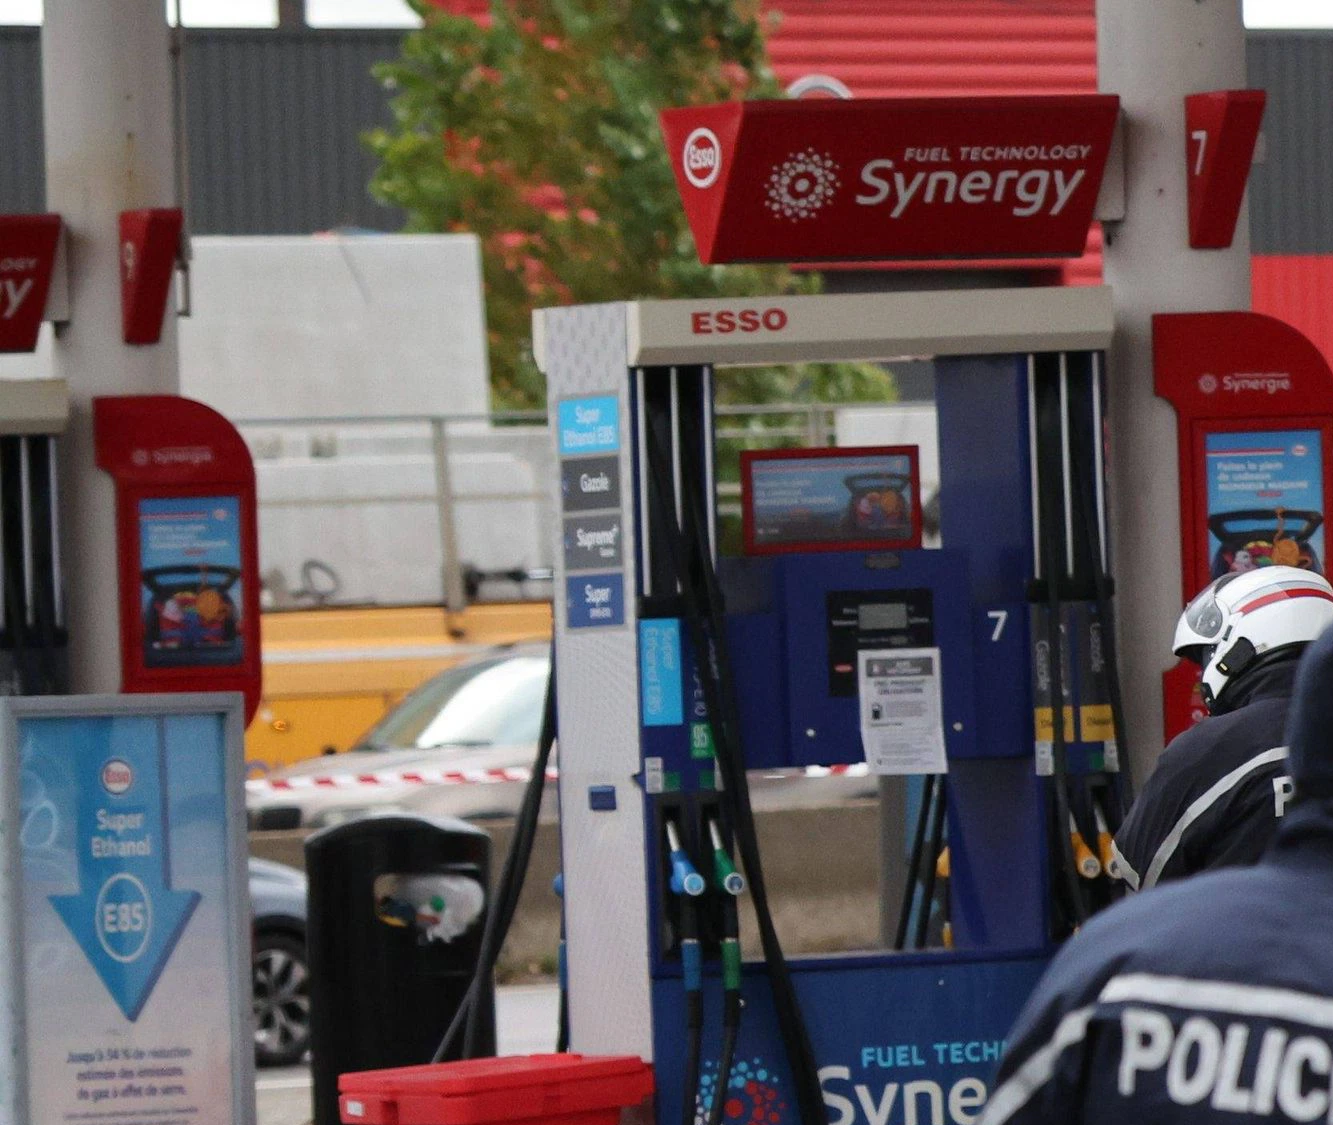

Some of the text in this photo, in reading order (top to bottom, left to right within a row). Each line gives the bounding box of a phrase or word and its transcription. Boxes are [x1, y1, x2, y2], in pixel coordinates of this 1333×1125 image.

[688, 146, 716, 169] Esso
[903, 144, 1091, 163] FUEL TECHNOLOGY
[1190, 130, 1207, 176] 7
[855, 159, 1087, 218] Synergy
[690, 308, 788, 336] ESSO
[580, 472, 610, 493] Gazole
[584, 583, 611, 605] Super
[987, 610, 1008, 642] 7
[96, 808, 144, 835] Super
[91, 836, 151, 859] Ethanol
[102, 902, 144, 933] E85
[861, 1044, 926, 1068] FUEL
